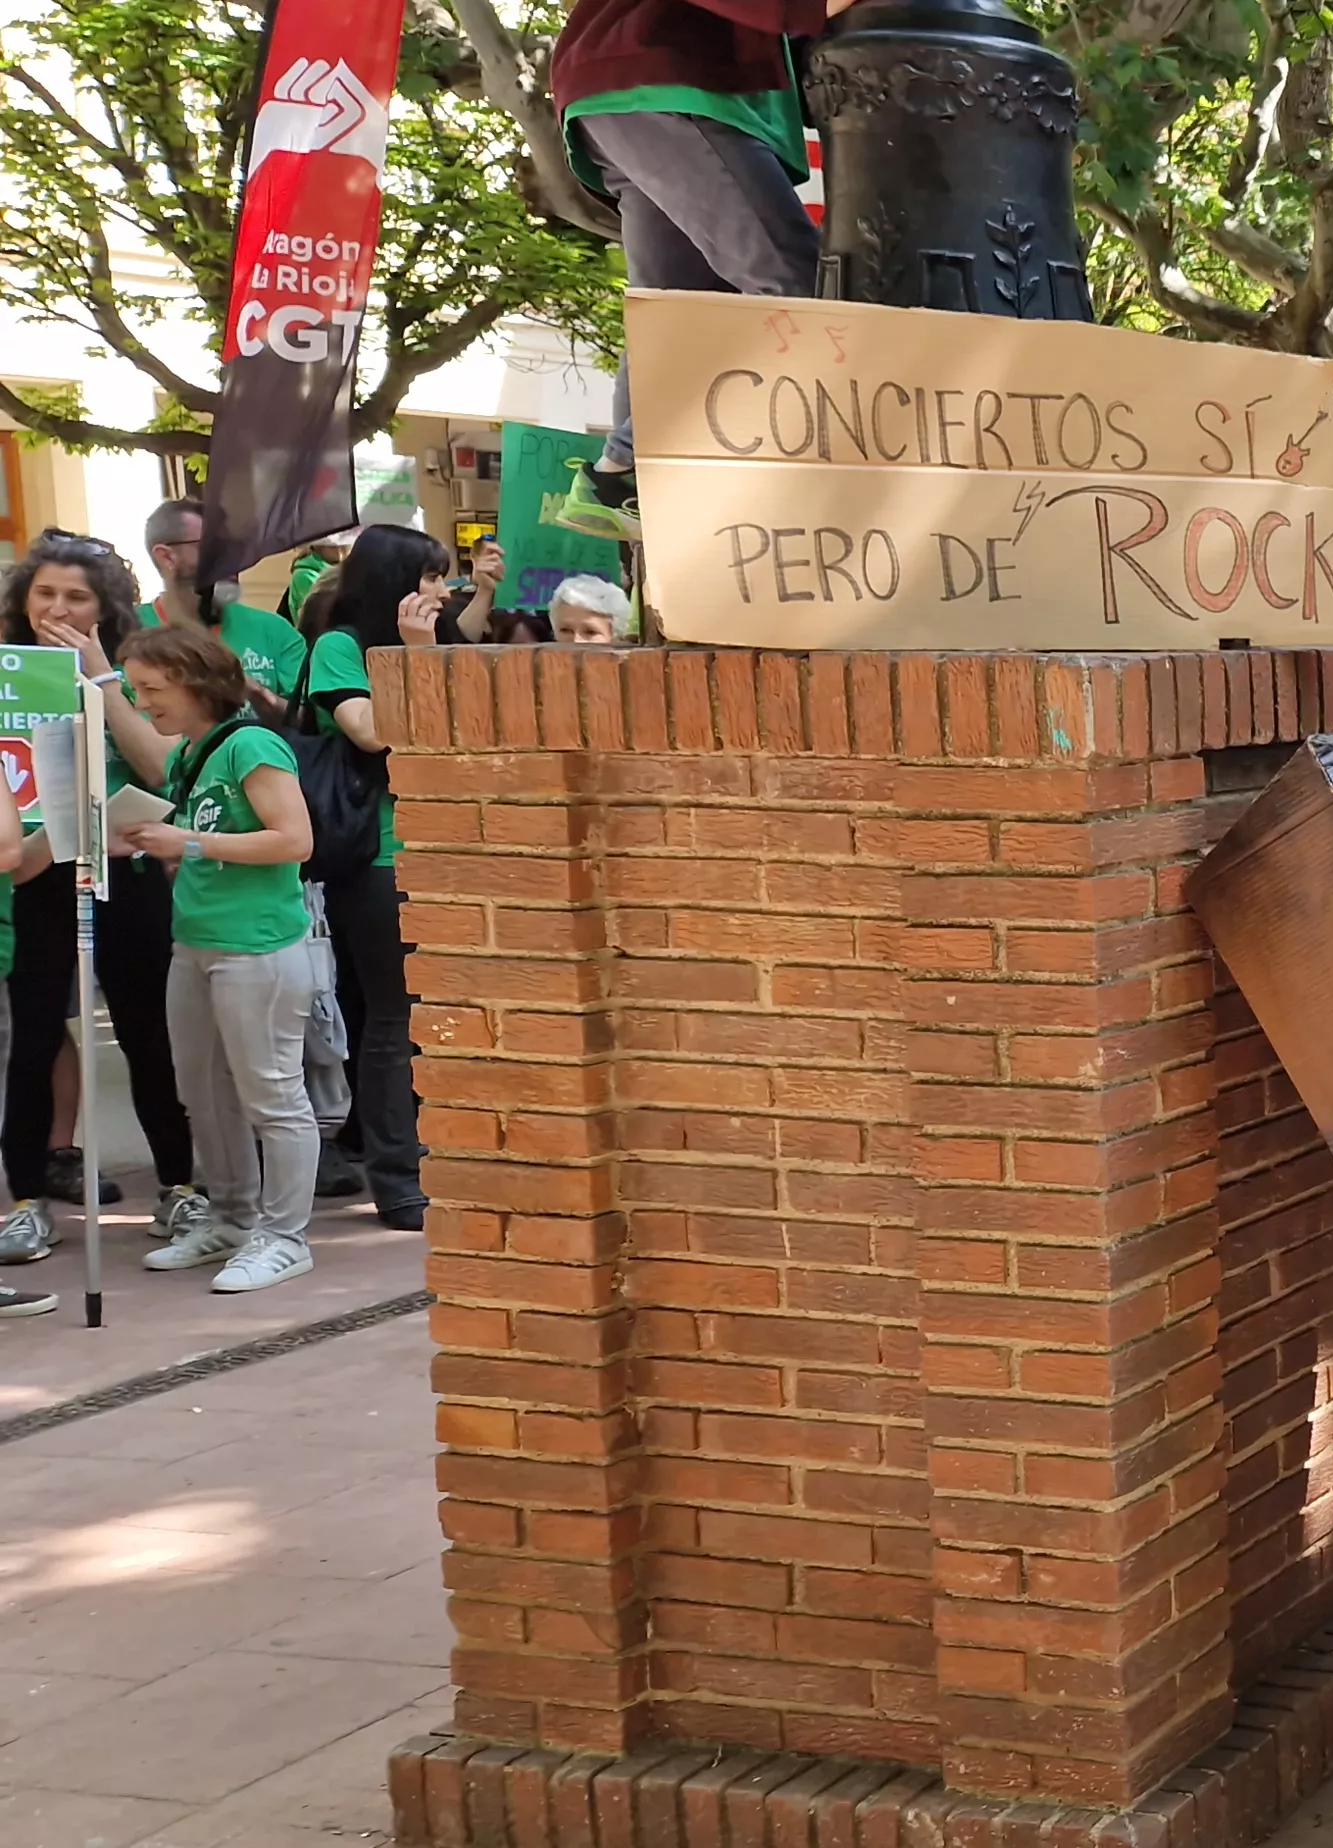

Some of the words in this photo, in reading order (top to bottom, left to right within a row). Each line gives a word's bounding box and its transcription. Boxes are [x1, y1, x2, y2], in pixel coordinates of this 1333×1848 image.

[236, 299, 362, 367] CGT
[705, 369, 1148, 473] CONCIERTOS
[1196, 394, 1273, 479] SÍ
[714, 521, 900, 605] PERO
[930, 530, 1023, 602] DE
